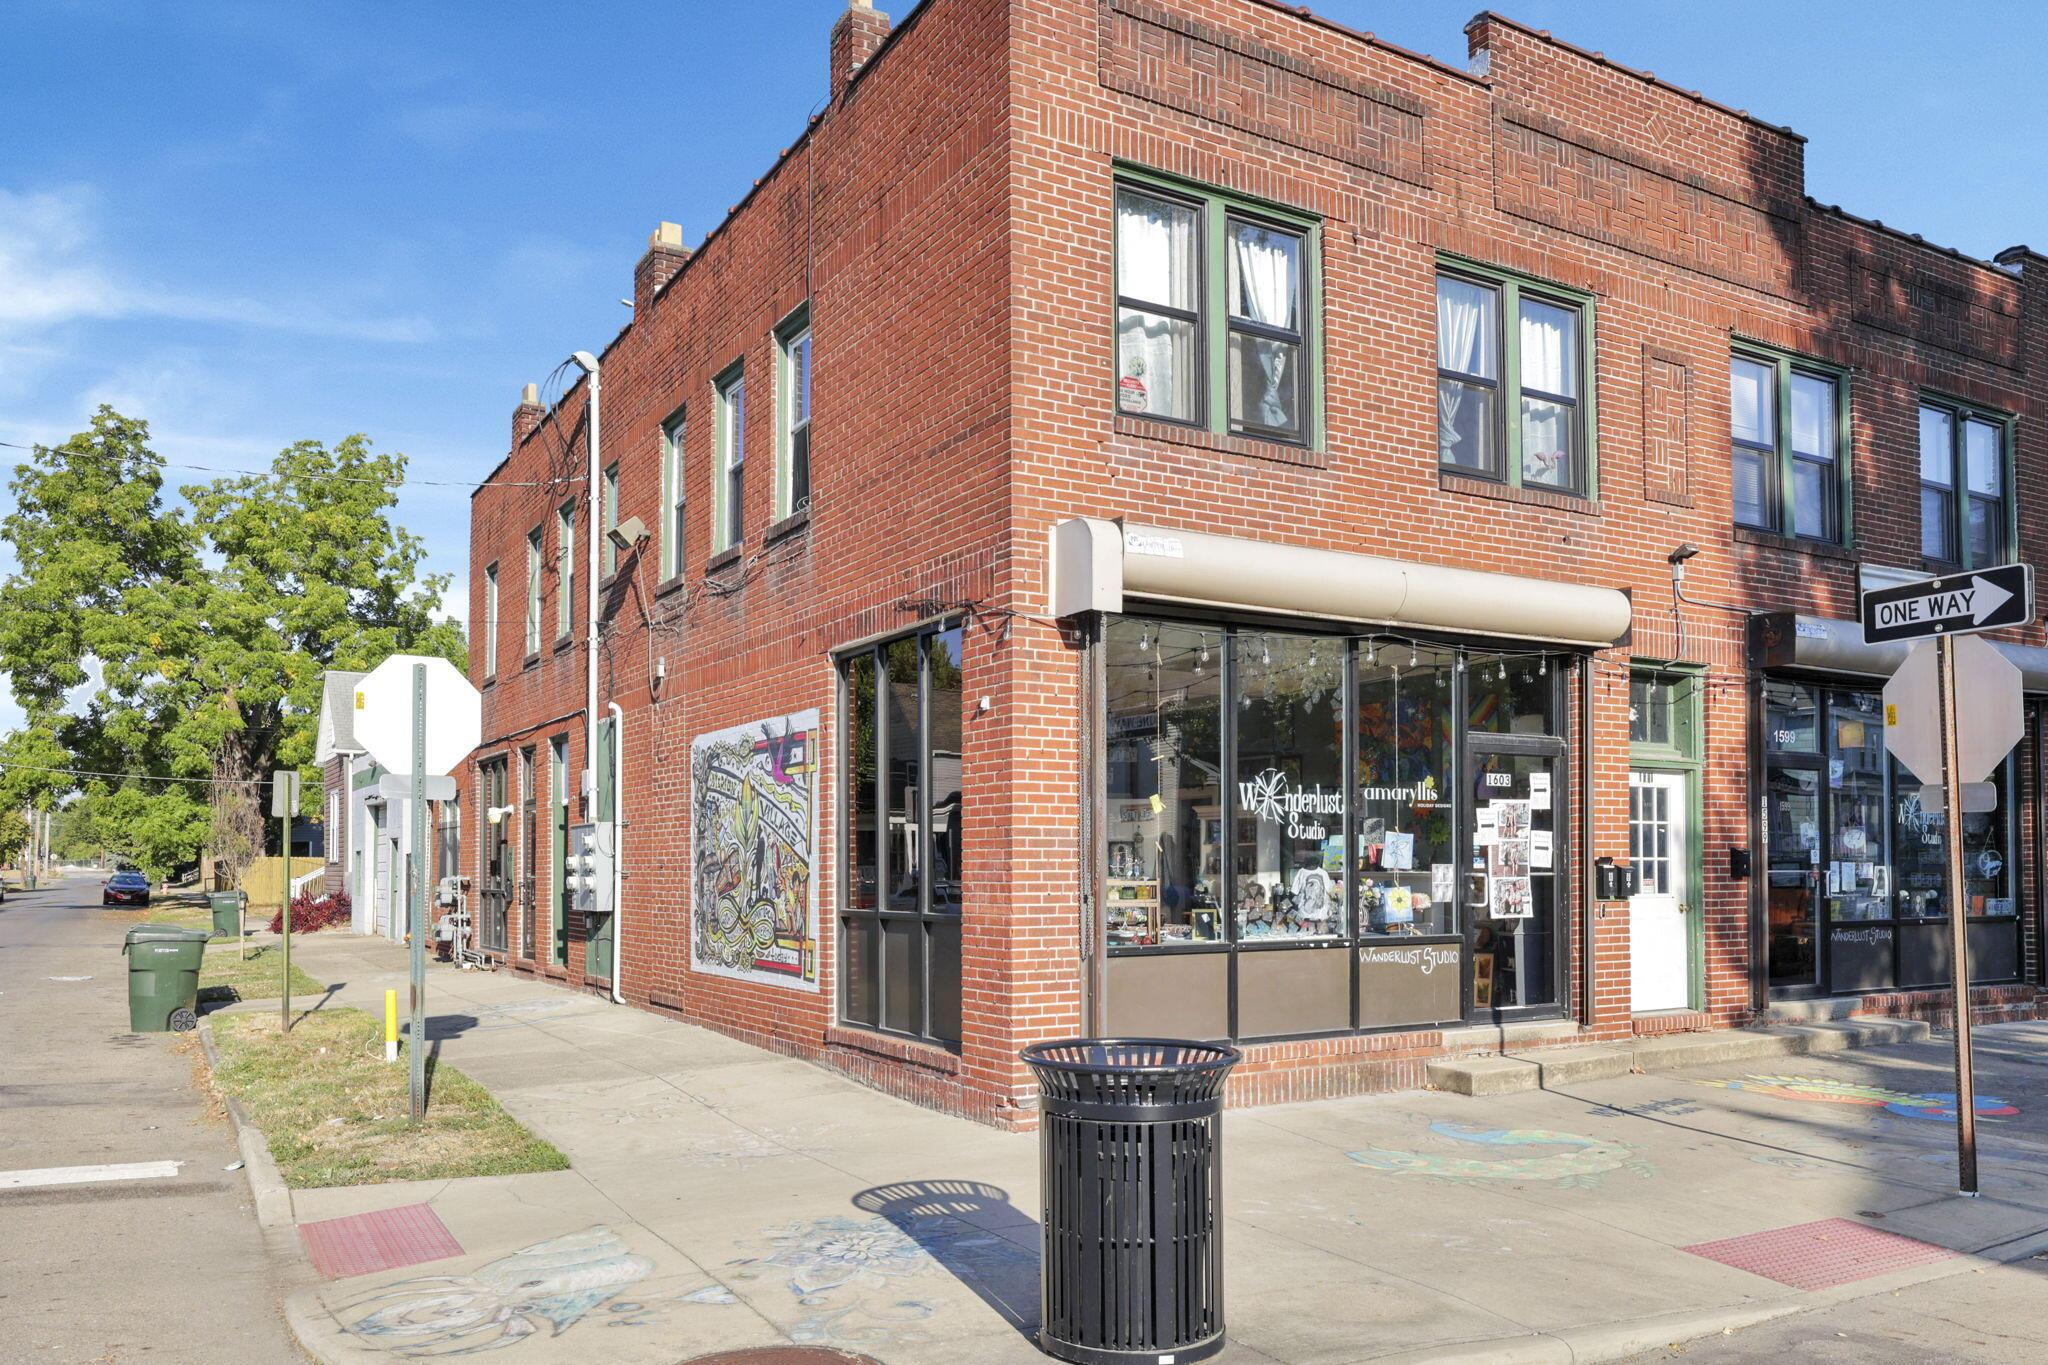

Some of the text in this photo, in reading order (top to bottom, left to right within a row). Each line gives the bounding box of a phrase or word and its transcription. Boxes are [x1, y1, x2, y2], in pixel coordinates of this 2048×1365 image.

[1880, 590, 1976, 625] ONE WAY
[1774, 730, 1796, 743] 1599
[1488, 774, 1511, 786] 1603
[1364, 781, 1438, 808] amaryllis
[760, 800, 801, 847] VILLAGE
[1287, 812, 1326, 839] Studio
[1830, 928, 1869, 942] WANDERLUST
[1359, 947, 1459, 975] WANDERLUST STUDIO
